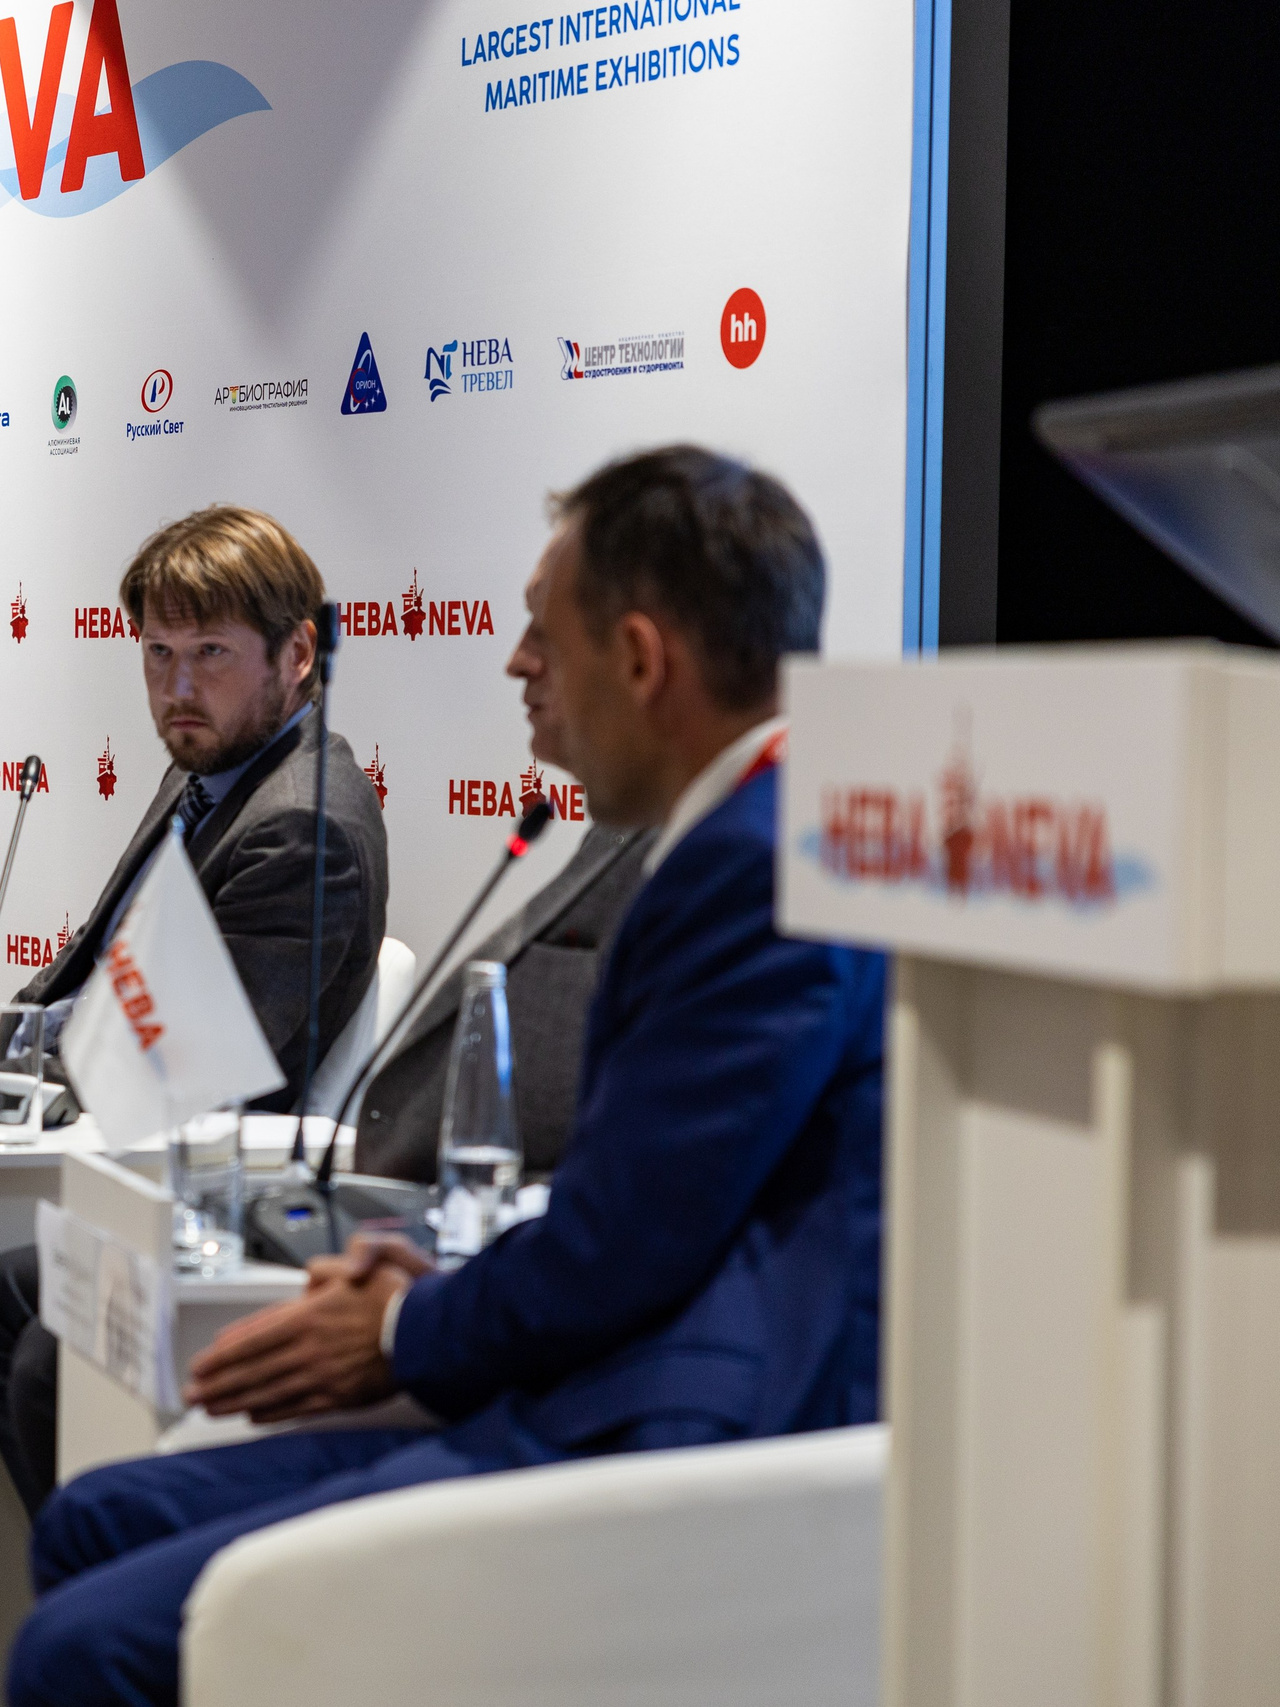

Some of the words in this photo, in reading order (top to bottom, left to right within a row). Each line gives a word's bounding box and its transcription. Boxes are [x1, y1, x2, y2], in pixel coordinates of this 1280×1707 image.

[461, 18, 553, 67] LARGEST
[485, 63, 588, 112] MARITIME
[596, 33, 740, 91] EXHIBITIONS
[730, 312, 757, 345] hh
[462, 337, 514, 367] НЕВА
[584, 345, 616, 367] ЦЕНТР
[618, 338, 684, 364] ТЕХНОЛОГИИ
[355, 380, 376, 390] ОРИОН
[461, 370, 513, 393] ТРЕВЕЛ
[584, 366, 631, 379] СУДОСТРОЕНИЯ
[638, 361, 684, 374] СУДОРЕМОНТА
[214, 379, 308, 405] АРТБИОГРАФИЯ
[48, 437, 81, 446] АЛЮМИНИЕВАЯ
[126, 420, 161, 441] Русский
[163, 420, 184, 434] Свет
[50, 446, 78, 455] АССОЦИАЦИЯ
[75, 607, 125, 638] НЕВА
[429, 600, 494, 636] NEVA
[2, 762, 49, 793] NEA
[449, 779, 516, 818] НЕВА
[549, 784, 585, 821] NE
[7, 934, 53, 968] НЕВА
